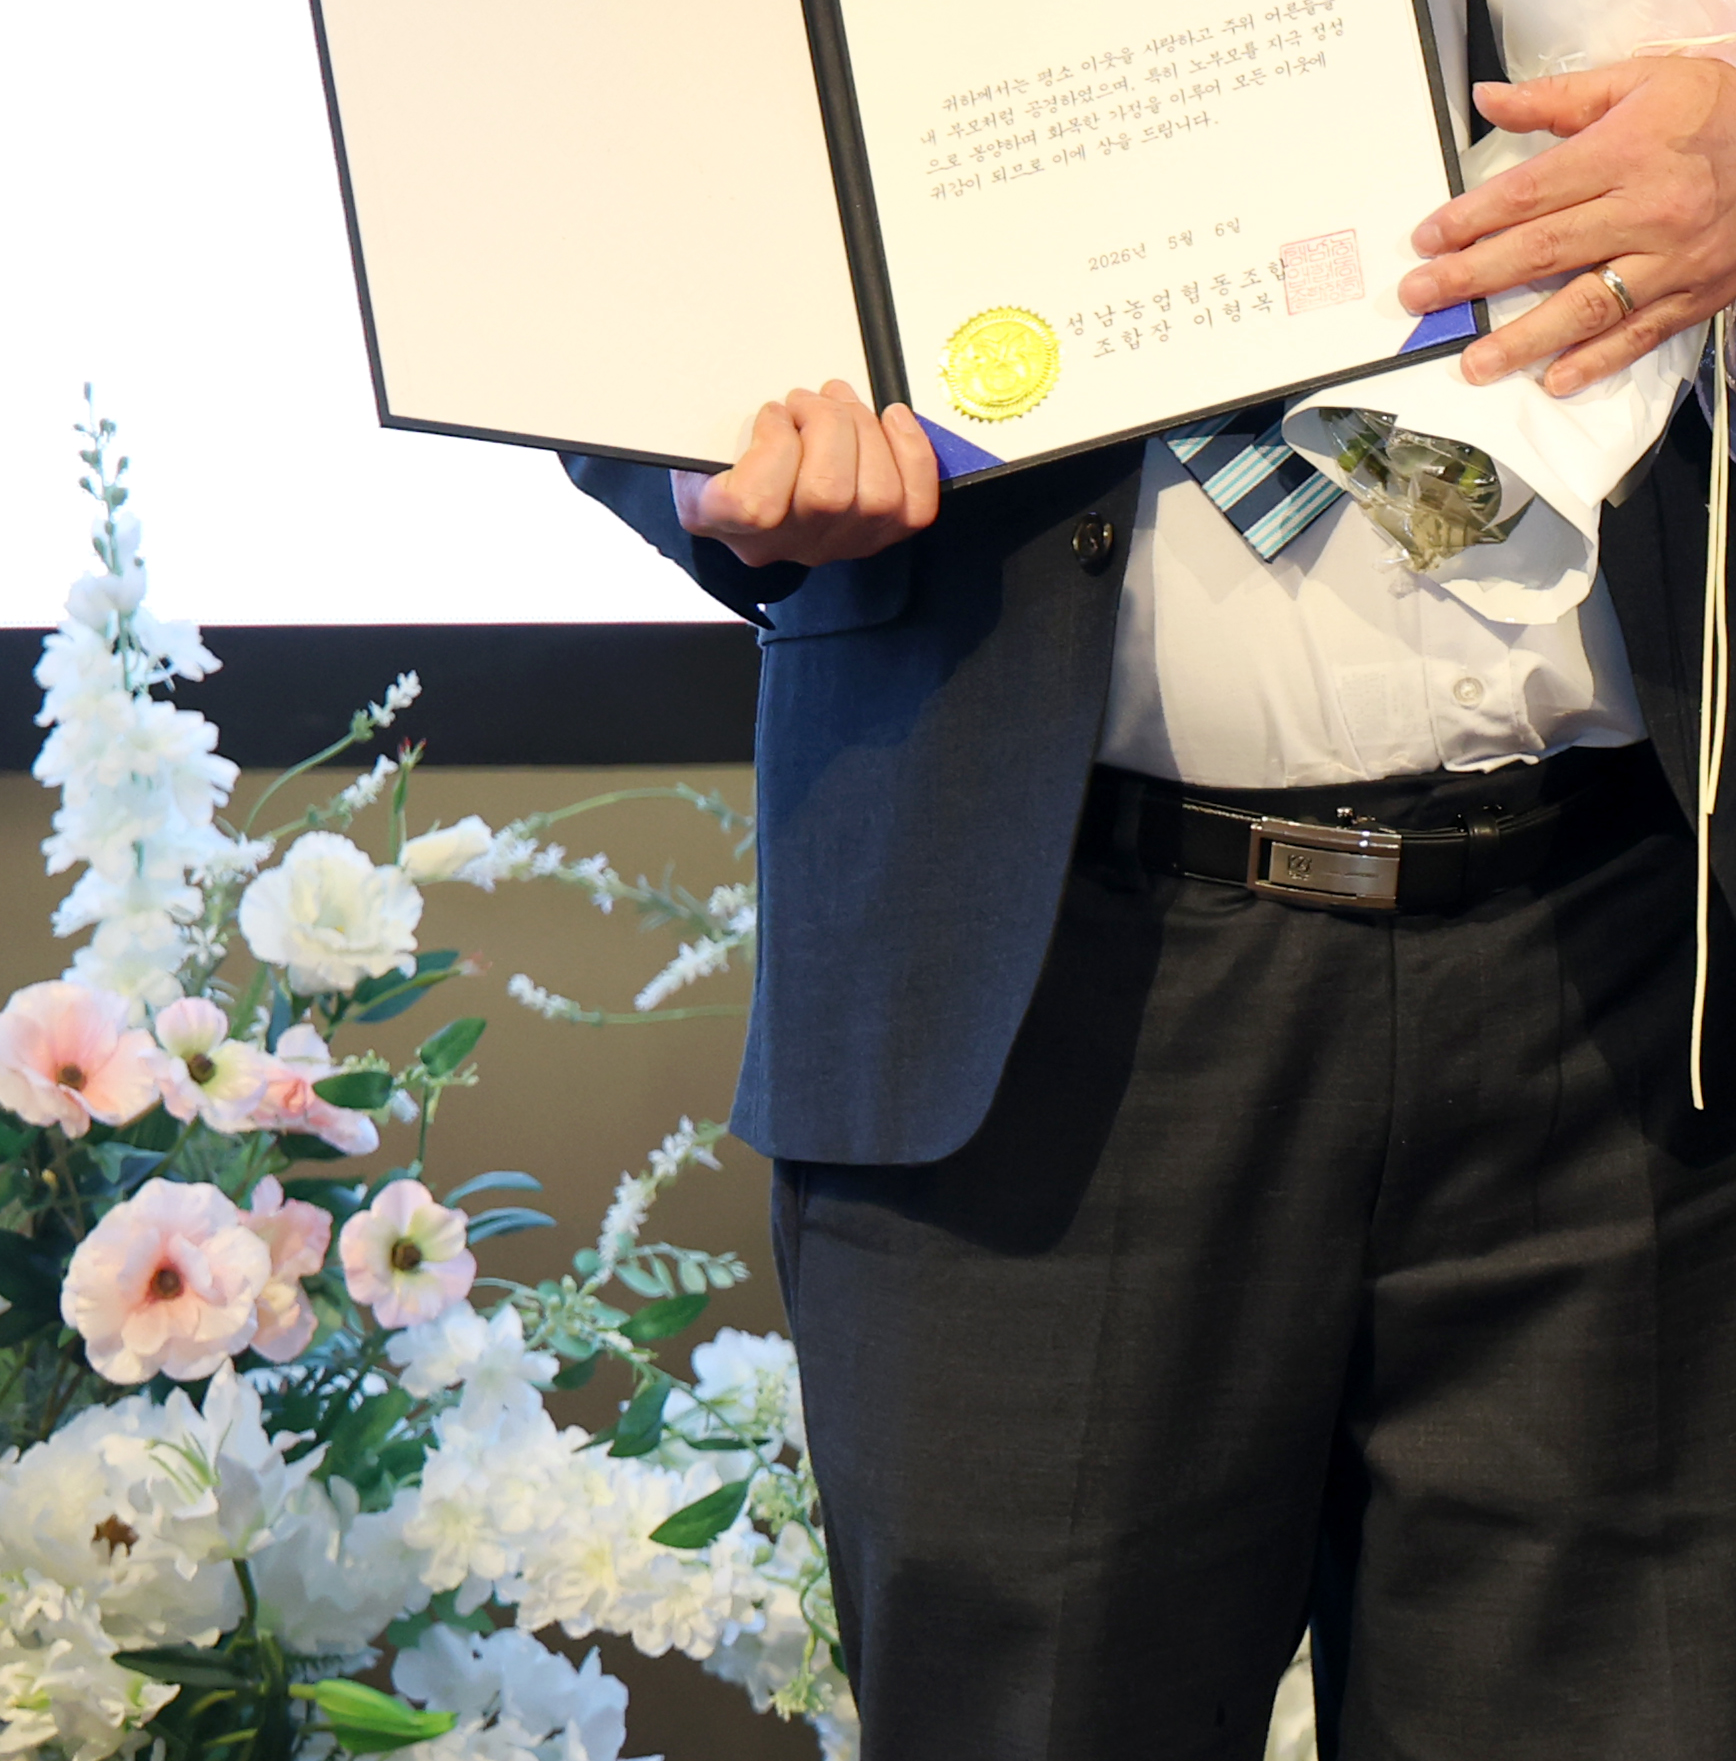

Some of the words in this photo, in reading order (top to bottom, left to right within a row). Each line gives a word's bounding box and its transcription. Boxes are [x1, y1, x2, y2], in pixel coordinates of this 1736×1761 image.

[920, 128, 937, 146] 내
[947, 107, 1015, 140] 부모처럼
[1144, 62, 1178, 84] 특히
[1189, 41, 1259, 75] 노부모를
[1267, 29, 1303, 51] 지극
[1311, 17, 1344, 42] 정성
[1037, 66, 1074, 87] 평소
[1081, 46, 1135, 73] 이웃을
[1143, 28, 1214, 56] 사랑하고
[1221, 13, 1255, 35] 주위
[926, 153, 962, 175] 으로
[969, 129, 1038, 163] 봉양하며
[1047, 112, 1101, 140] 화목한
[1109, 95, 1162, 122] 가정을
[1170, 78, 1221, 106] 이루어
[1232, 68, 1267, 91] 모든
[1275, 51, 1327, 78] 이웃에
[930, 173, 981, 200] 귀감이
[992, 158, 1045, 184] 되므로
[1053, 143, 1086, 167] 이에
[1096, 132, 1132, 155] 상을
[1141, 110, 1219, 143] 드립니다.
[1088, 242, 1147, 272] 2026년
[1168, 229, 1194, 250] 5월
[1214, 217, 1241, 238] 6일
